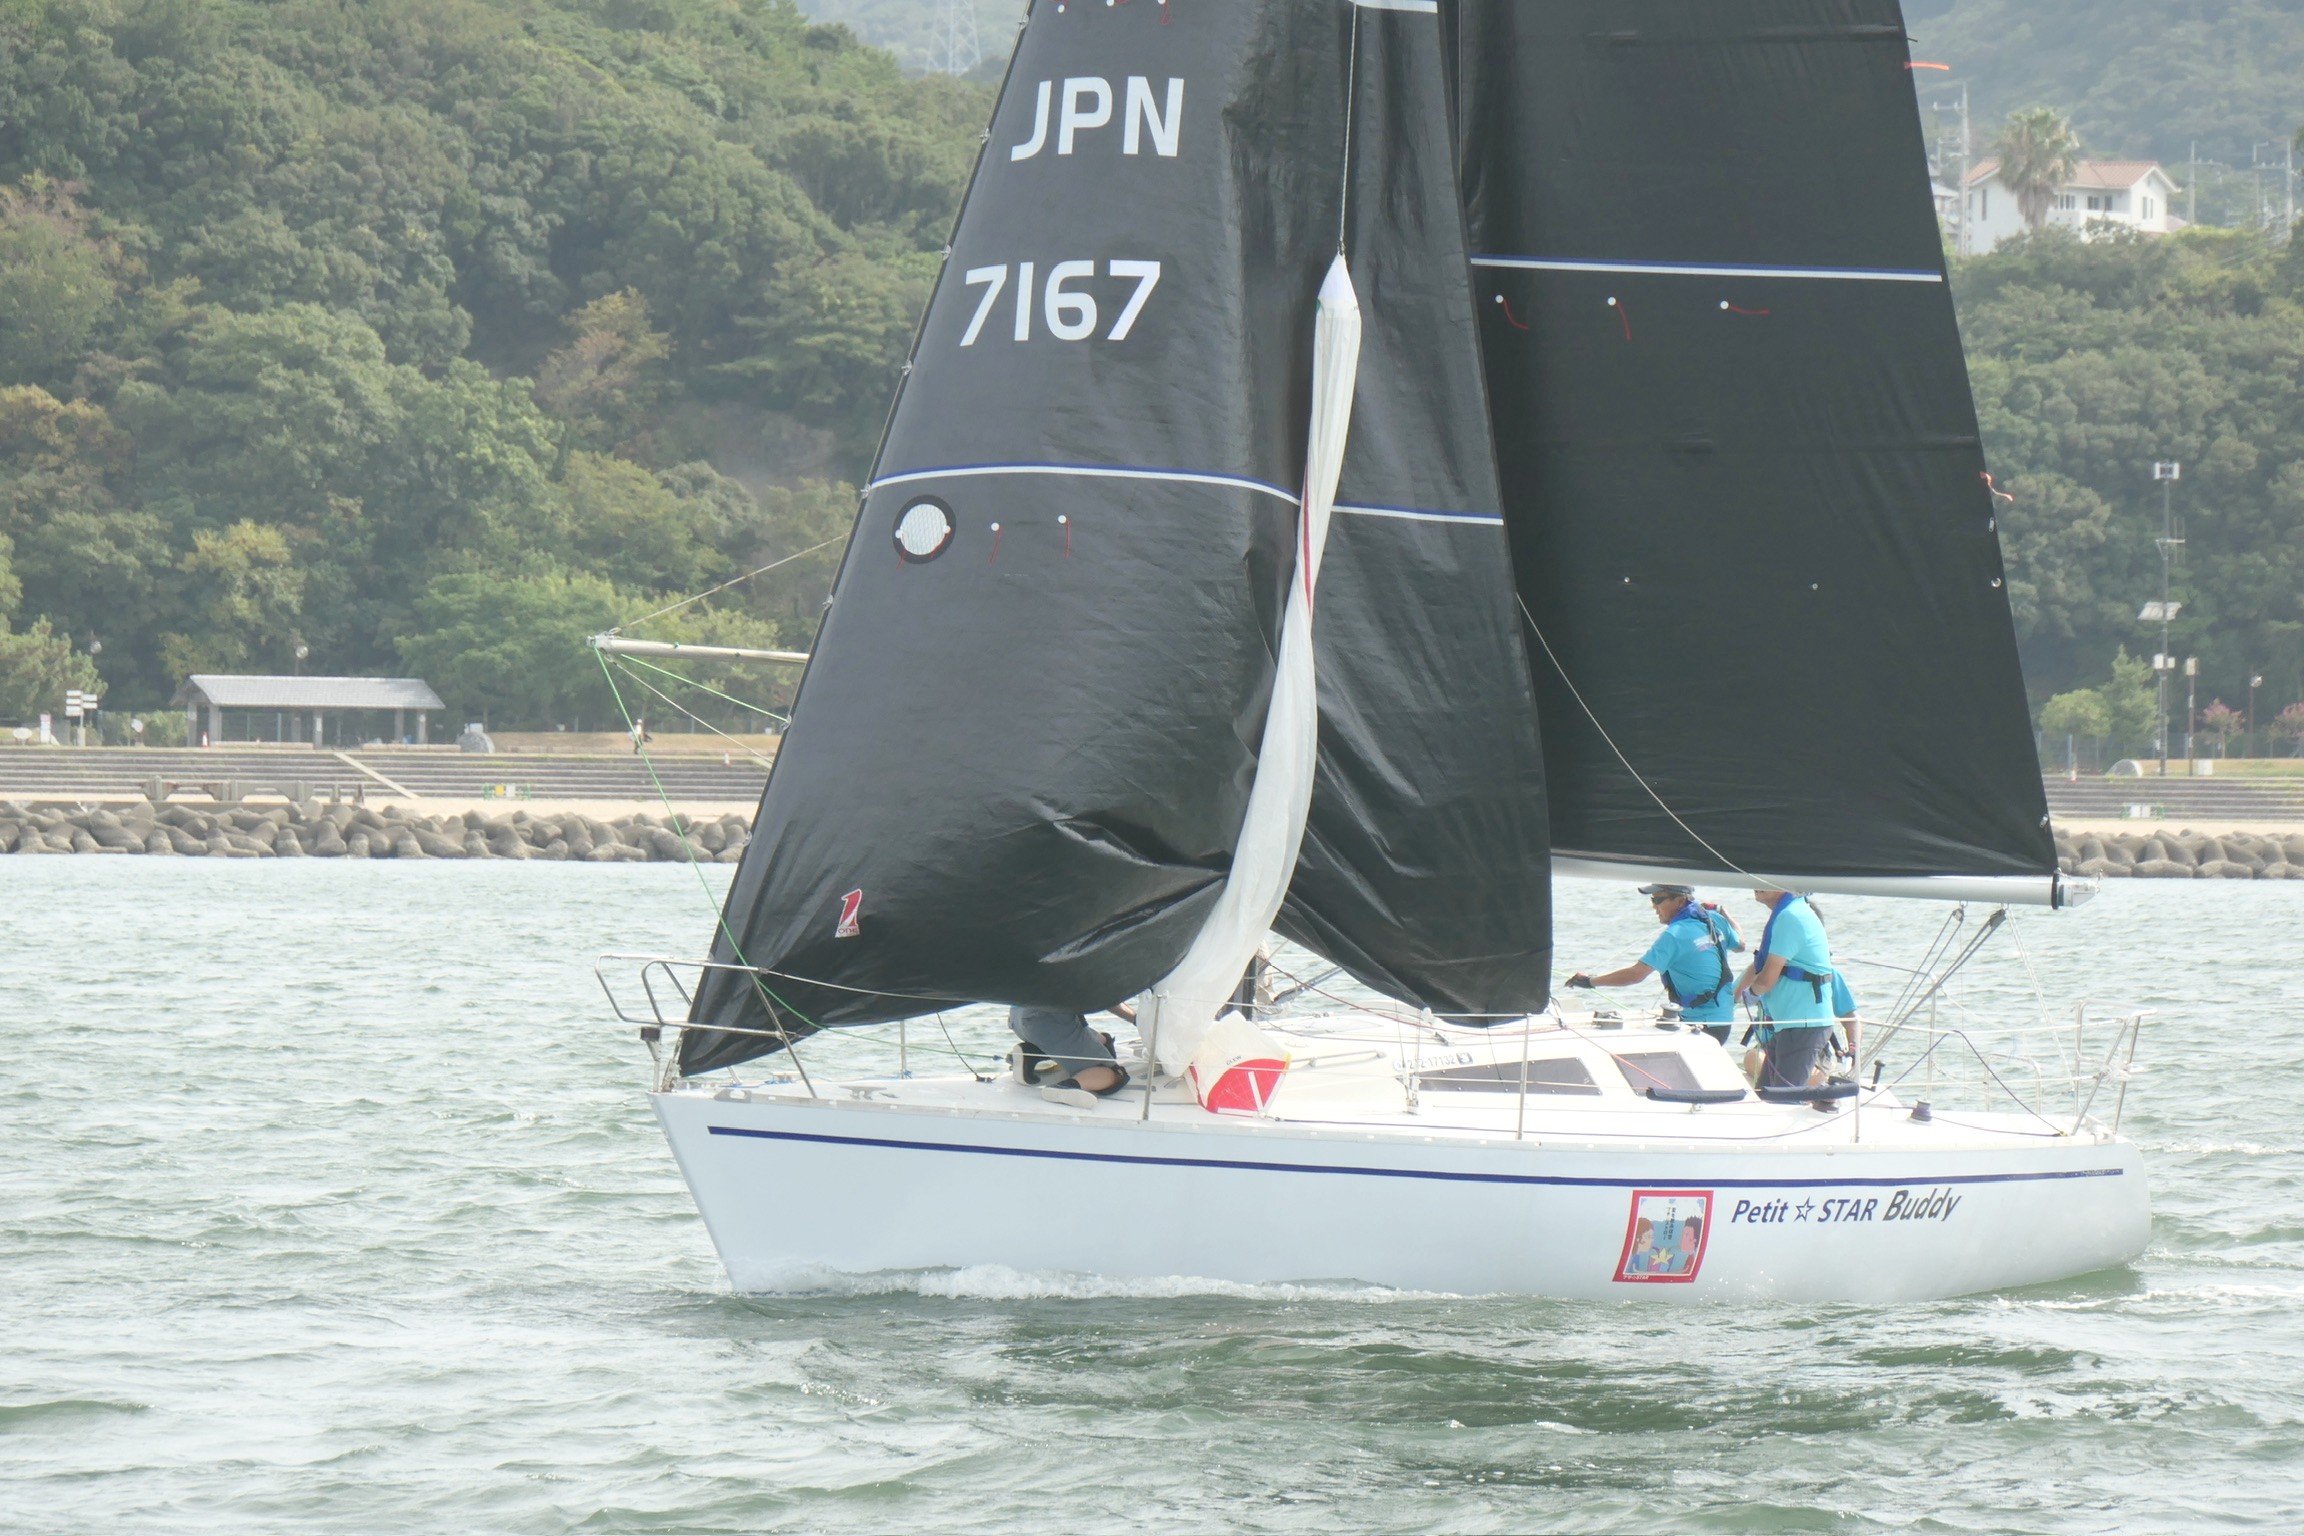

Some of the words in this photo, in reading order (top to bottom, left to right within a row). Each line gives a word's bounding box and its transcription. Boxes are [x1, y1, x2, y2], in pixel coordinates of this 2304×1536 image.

[1011, 76, 1184, 161] JPN
[960, 259, 1160, 346] 7167
[1731, 1198, 1788, 1223] Petit
[1817, 1199, 1878, 1222] STAR
[1882, 1187, 1962, 1222] Buddy
